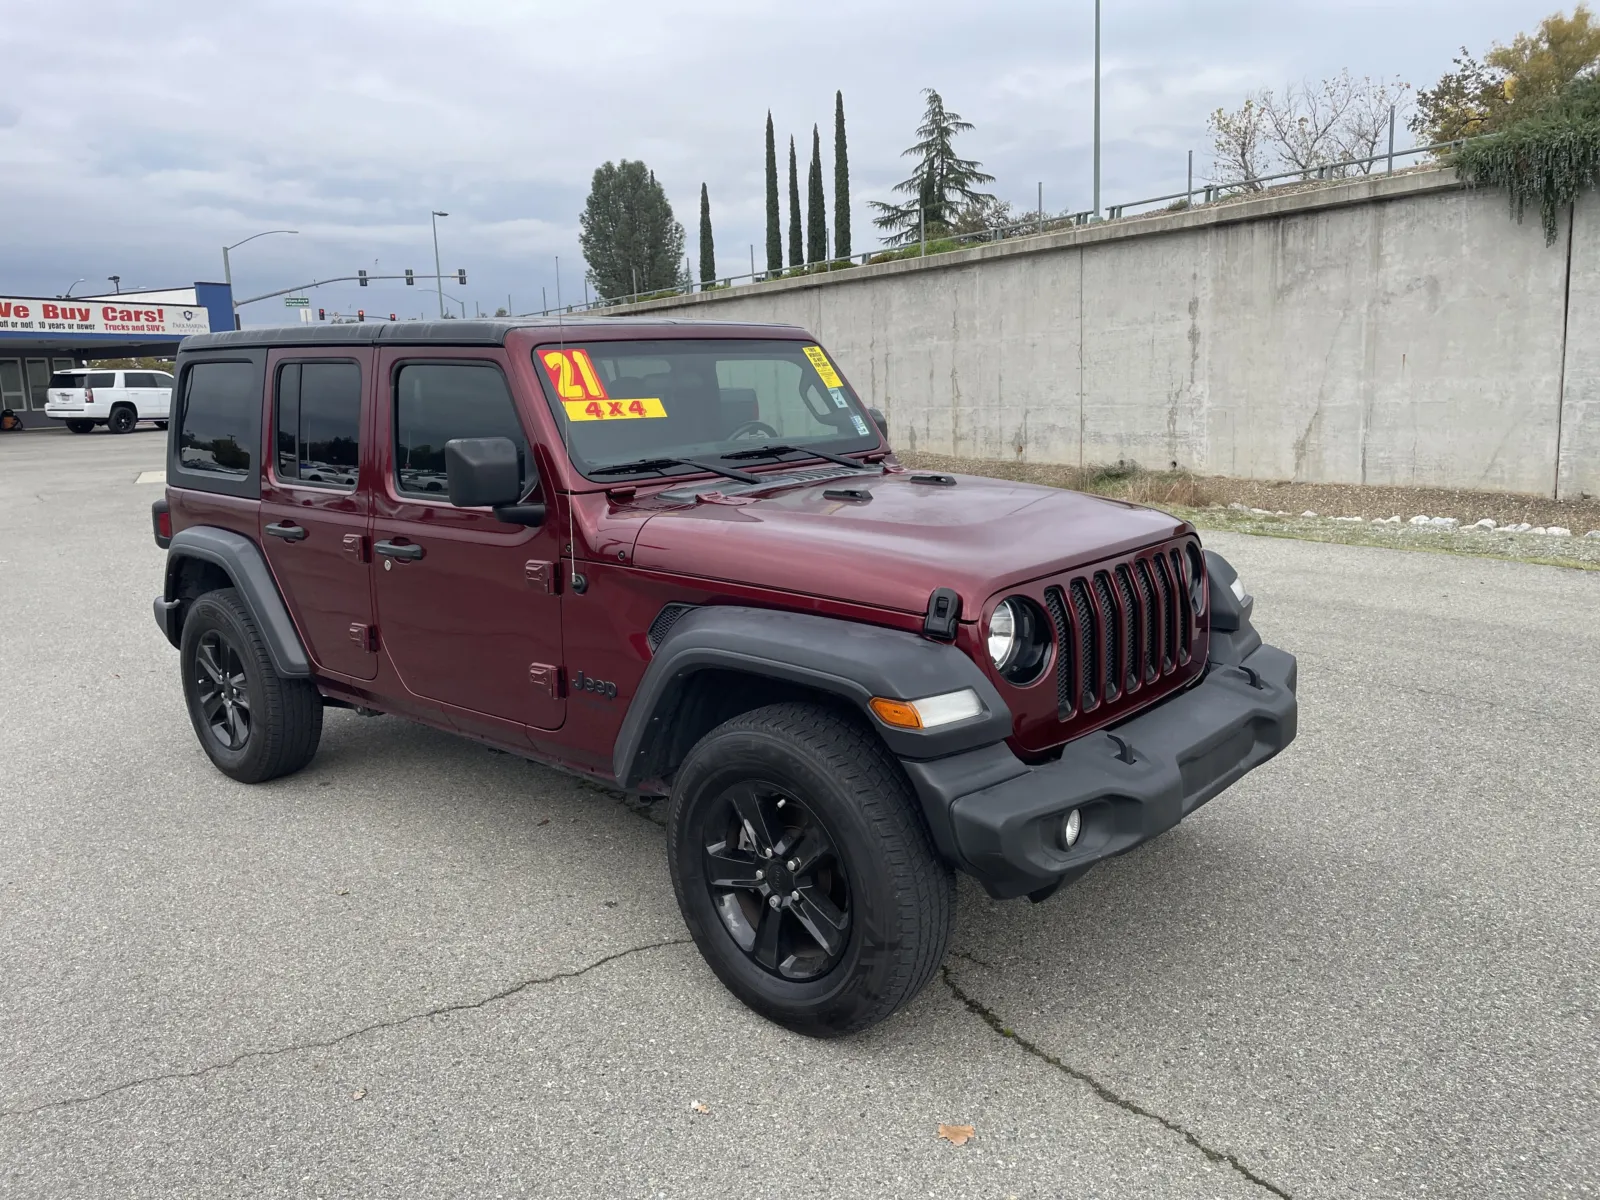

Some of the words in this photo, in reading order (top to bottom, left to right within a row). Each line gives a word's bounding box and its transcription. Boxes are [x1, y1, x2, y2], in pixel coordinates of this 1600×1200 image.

[42, 303, 91, 322] Buy
[101, 305, 165, 323] Cars!
[20, 321, 34, 329] not!
[38, 321, 46, 329] 10
[48, 322, 66, 330] years
[104, 323, 130, 331] Trucks
[131, 324, 145, 332] and
[146, 324, 166, 332] SUV's
[543, 350, 605, 400] 21
[571, 670, 618, 701] Jeep
